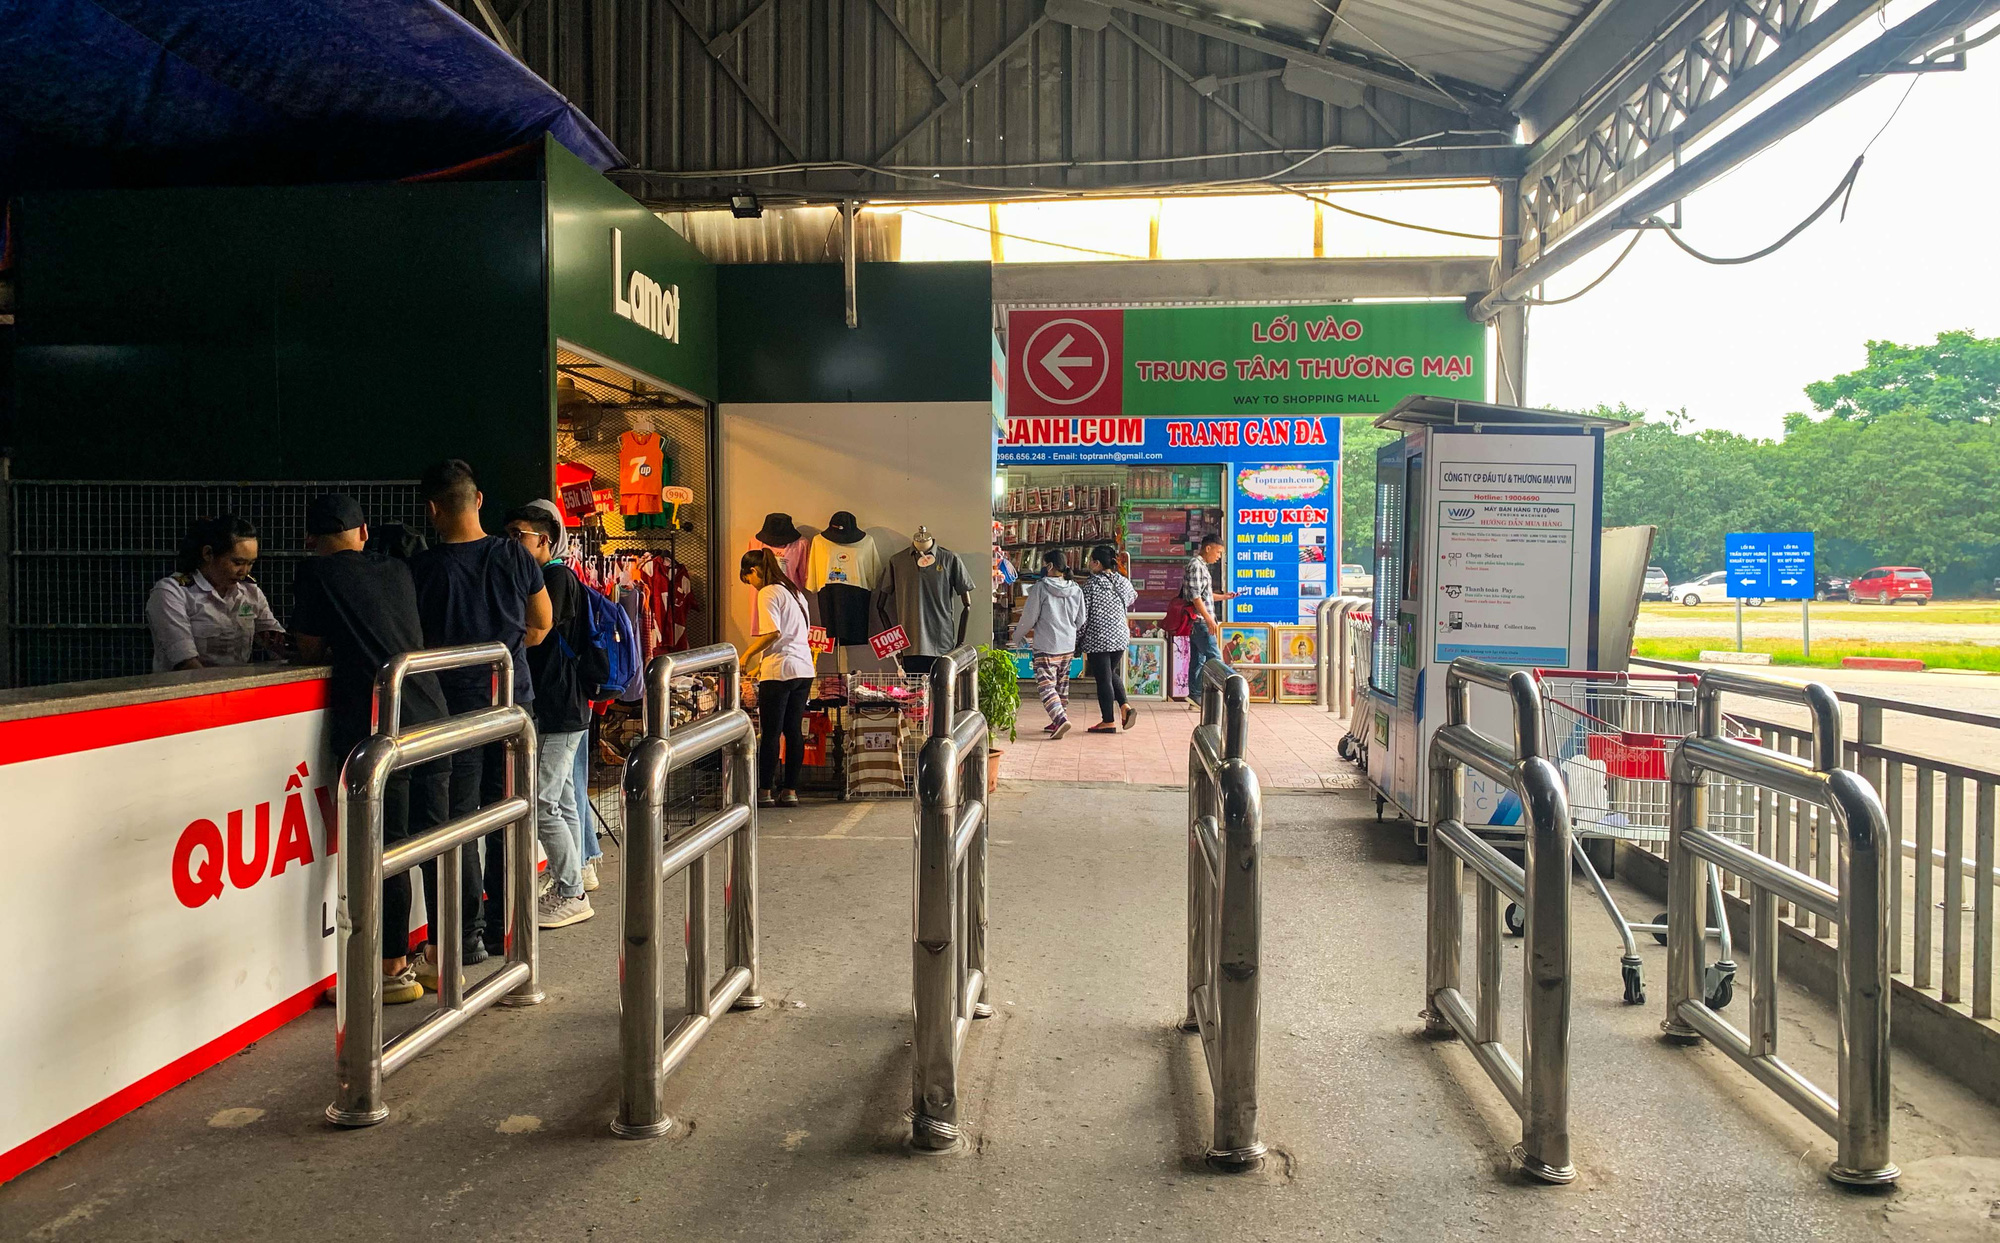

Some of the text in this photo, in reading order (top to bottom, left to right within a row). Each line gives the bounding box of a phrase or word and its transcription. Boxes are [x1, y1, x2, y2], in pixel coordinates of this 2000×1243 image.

[612, 227, 680, 345] Lamot
[1252, 315, 1363, 343] LỐI VÀO
[1135, 354, 1472, 382] TRUNG TÂM THƯƠNG MẠI
[1234, 394, 1379, 404] WAY TO SHOPPING MALL
[1167, 422, 1240, 447] TRANH
[1080, 452, 1162, 462] toptranh@gmail.com
[1254, 476, 1314, 485] Toptranh.com
[1240, 505, 1328, 527] PHỤ KIỆN
[1237, 549, 1273, 560] CHỈ THÊU
[1237, 568, 1275, 578] KIM THÊU
[1255, 584, 1278, 596] CHẤM
[1237, 602, 1253, 612] KÉO
[873, 628, 903, 648] 100K
[888, 645, 894, 653] 3
[894, 640, 905, 650] SP
[172, 761, 338, 909] QUẦY
